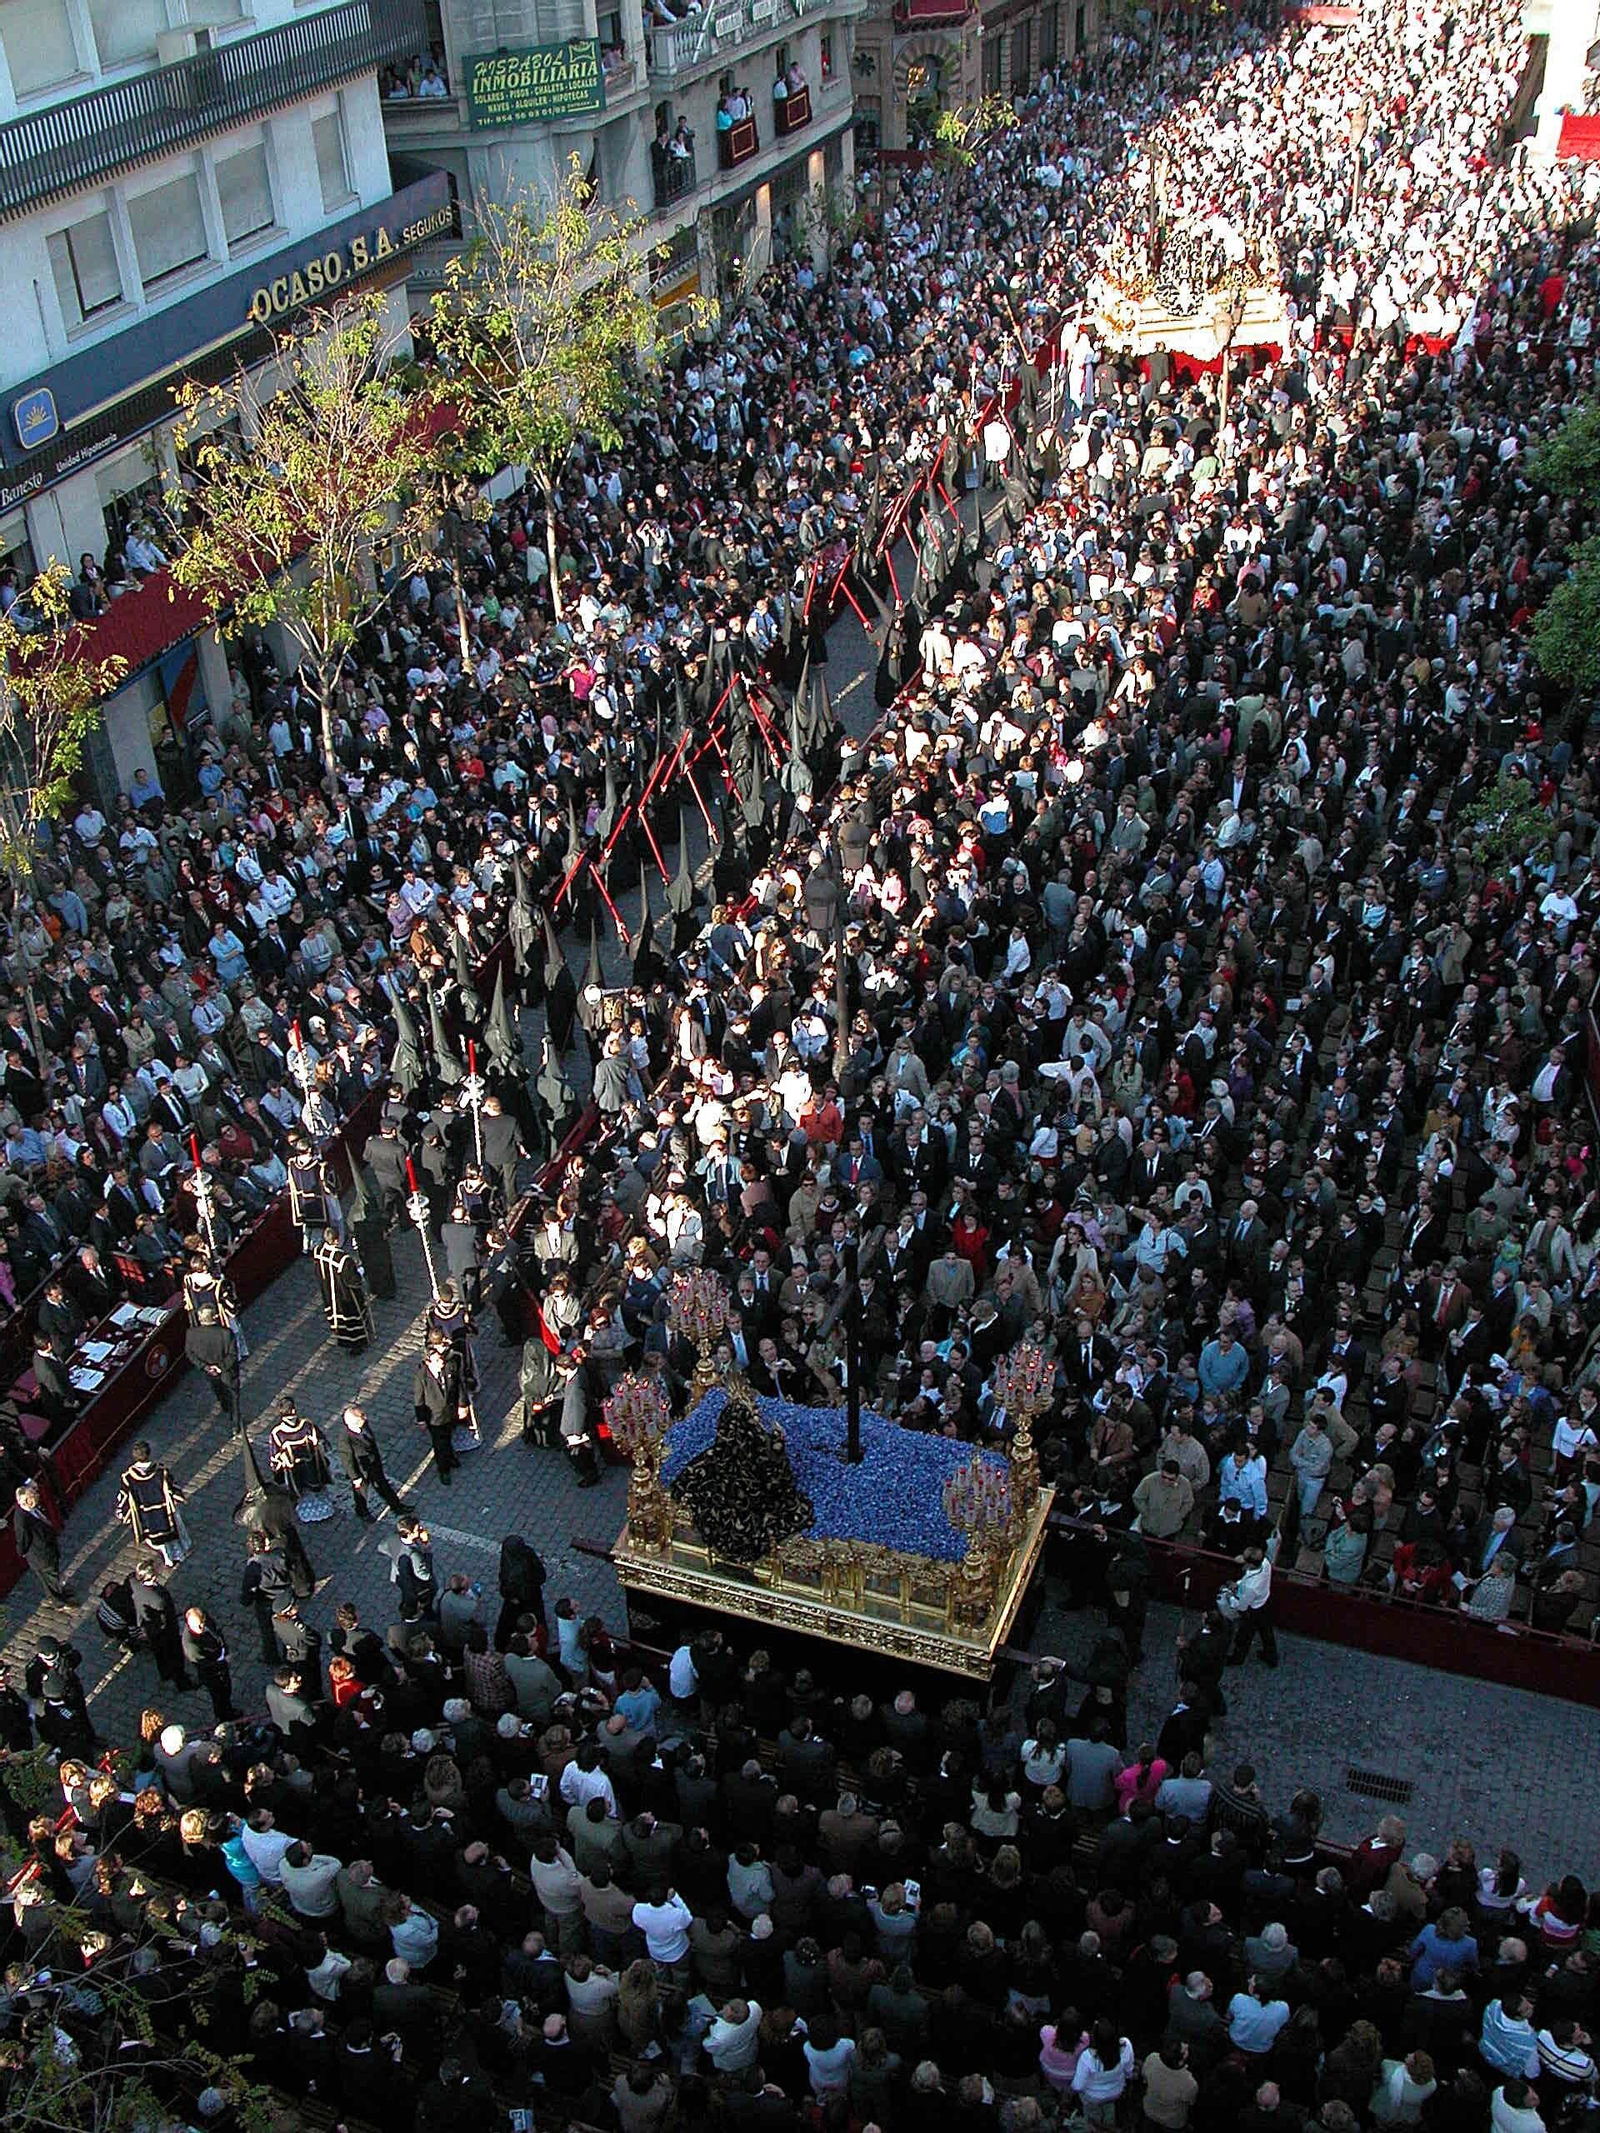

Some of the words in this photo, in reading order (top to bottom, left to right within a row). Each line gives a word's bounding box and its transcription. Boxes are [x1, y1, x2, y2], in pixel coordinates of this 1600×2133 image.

[473, 62, 598, 93] INMOBILIARIA
[475, 50, 563, 77] HISPABOL
[474, 92, 504, 105] SOLARES
[510, 88, 530, 99] PISOS
[534, 83, 565, 96] CHALETS
[568, 78, 598, 90] LOCALES
[487, 101, 510, 114] NAVES
[515, 95, 547, 108] ALQUILER
[552, 90, 589, 103] HIPOTECAS
[56, 450, 80, 472] Unidad
[80, 433, 118, 459] Hipotecaria
[1, 472, 43, 506] Banesto
